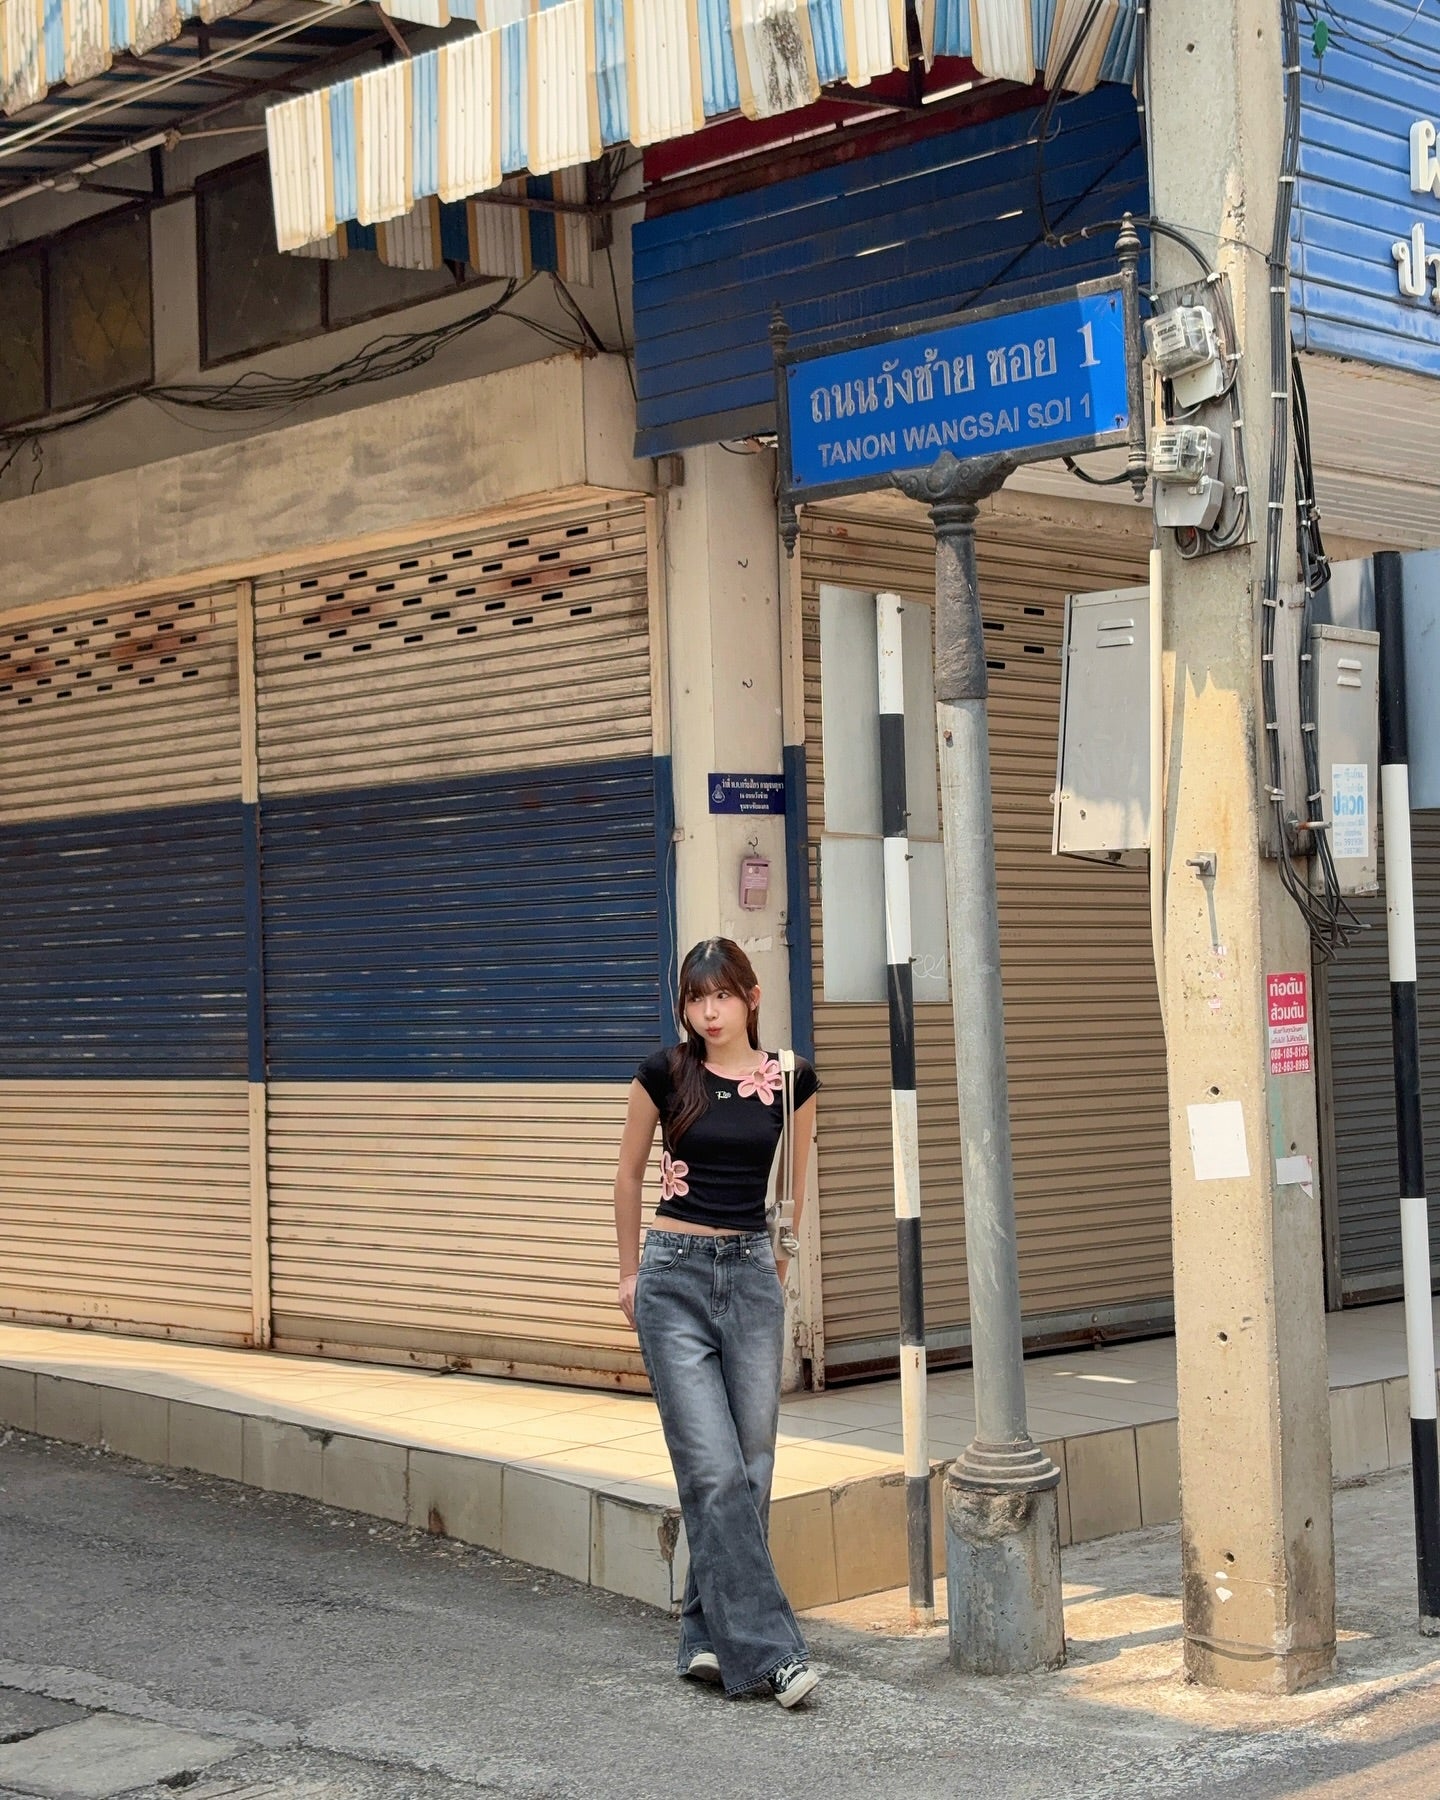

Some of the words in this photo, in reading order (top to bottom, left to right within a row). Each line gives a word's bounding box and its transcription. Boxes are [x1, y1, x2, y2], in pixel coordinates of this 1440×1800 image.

[810, 348, 975, 424] ถนนวังซ้าย
[986, 337, 1057, 387] ซอย
[1076, 320, 1101, 369] 1
[818, 430, 896, 468] TANON
[903, 405, 1020, 450] WANGSAI
[1027, 396, 1071, 429] SOI
[1080, 392, 1091, 418] 1
[1269, 977, 1303, 996] ท่อตัน
[1270, 1001, 1304, 1021] ส้วมตัน
